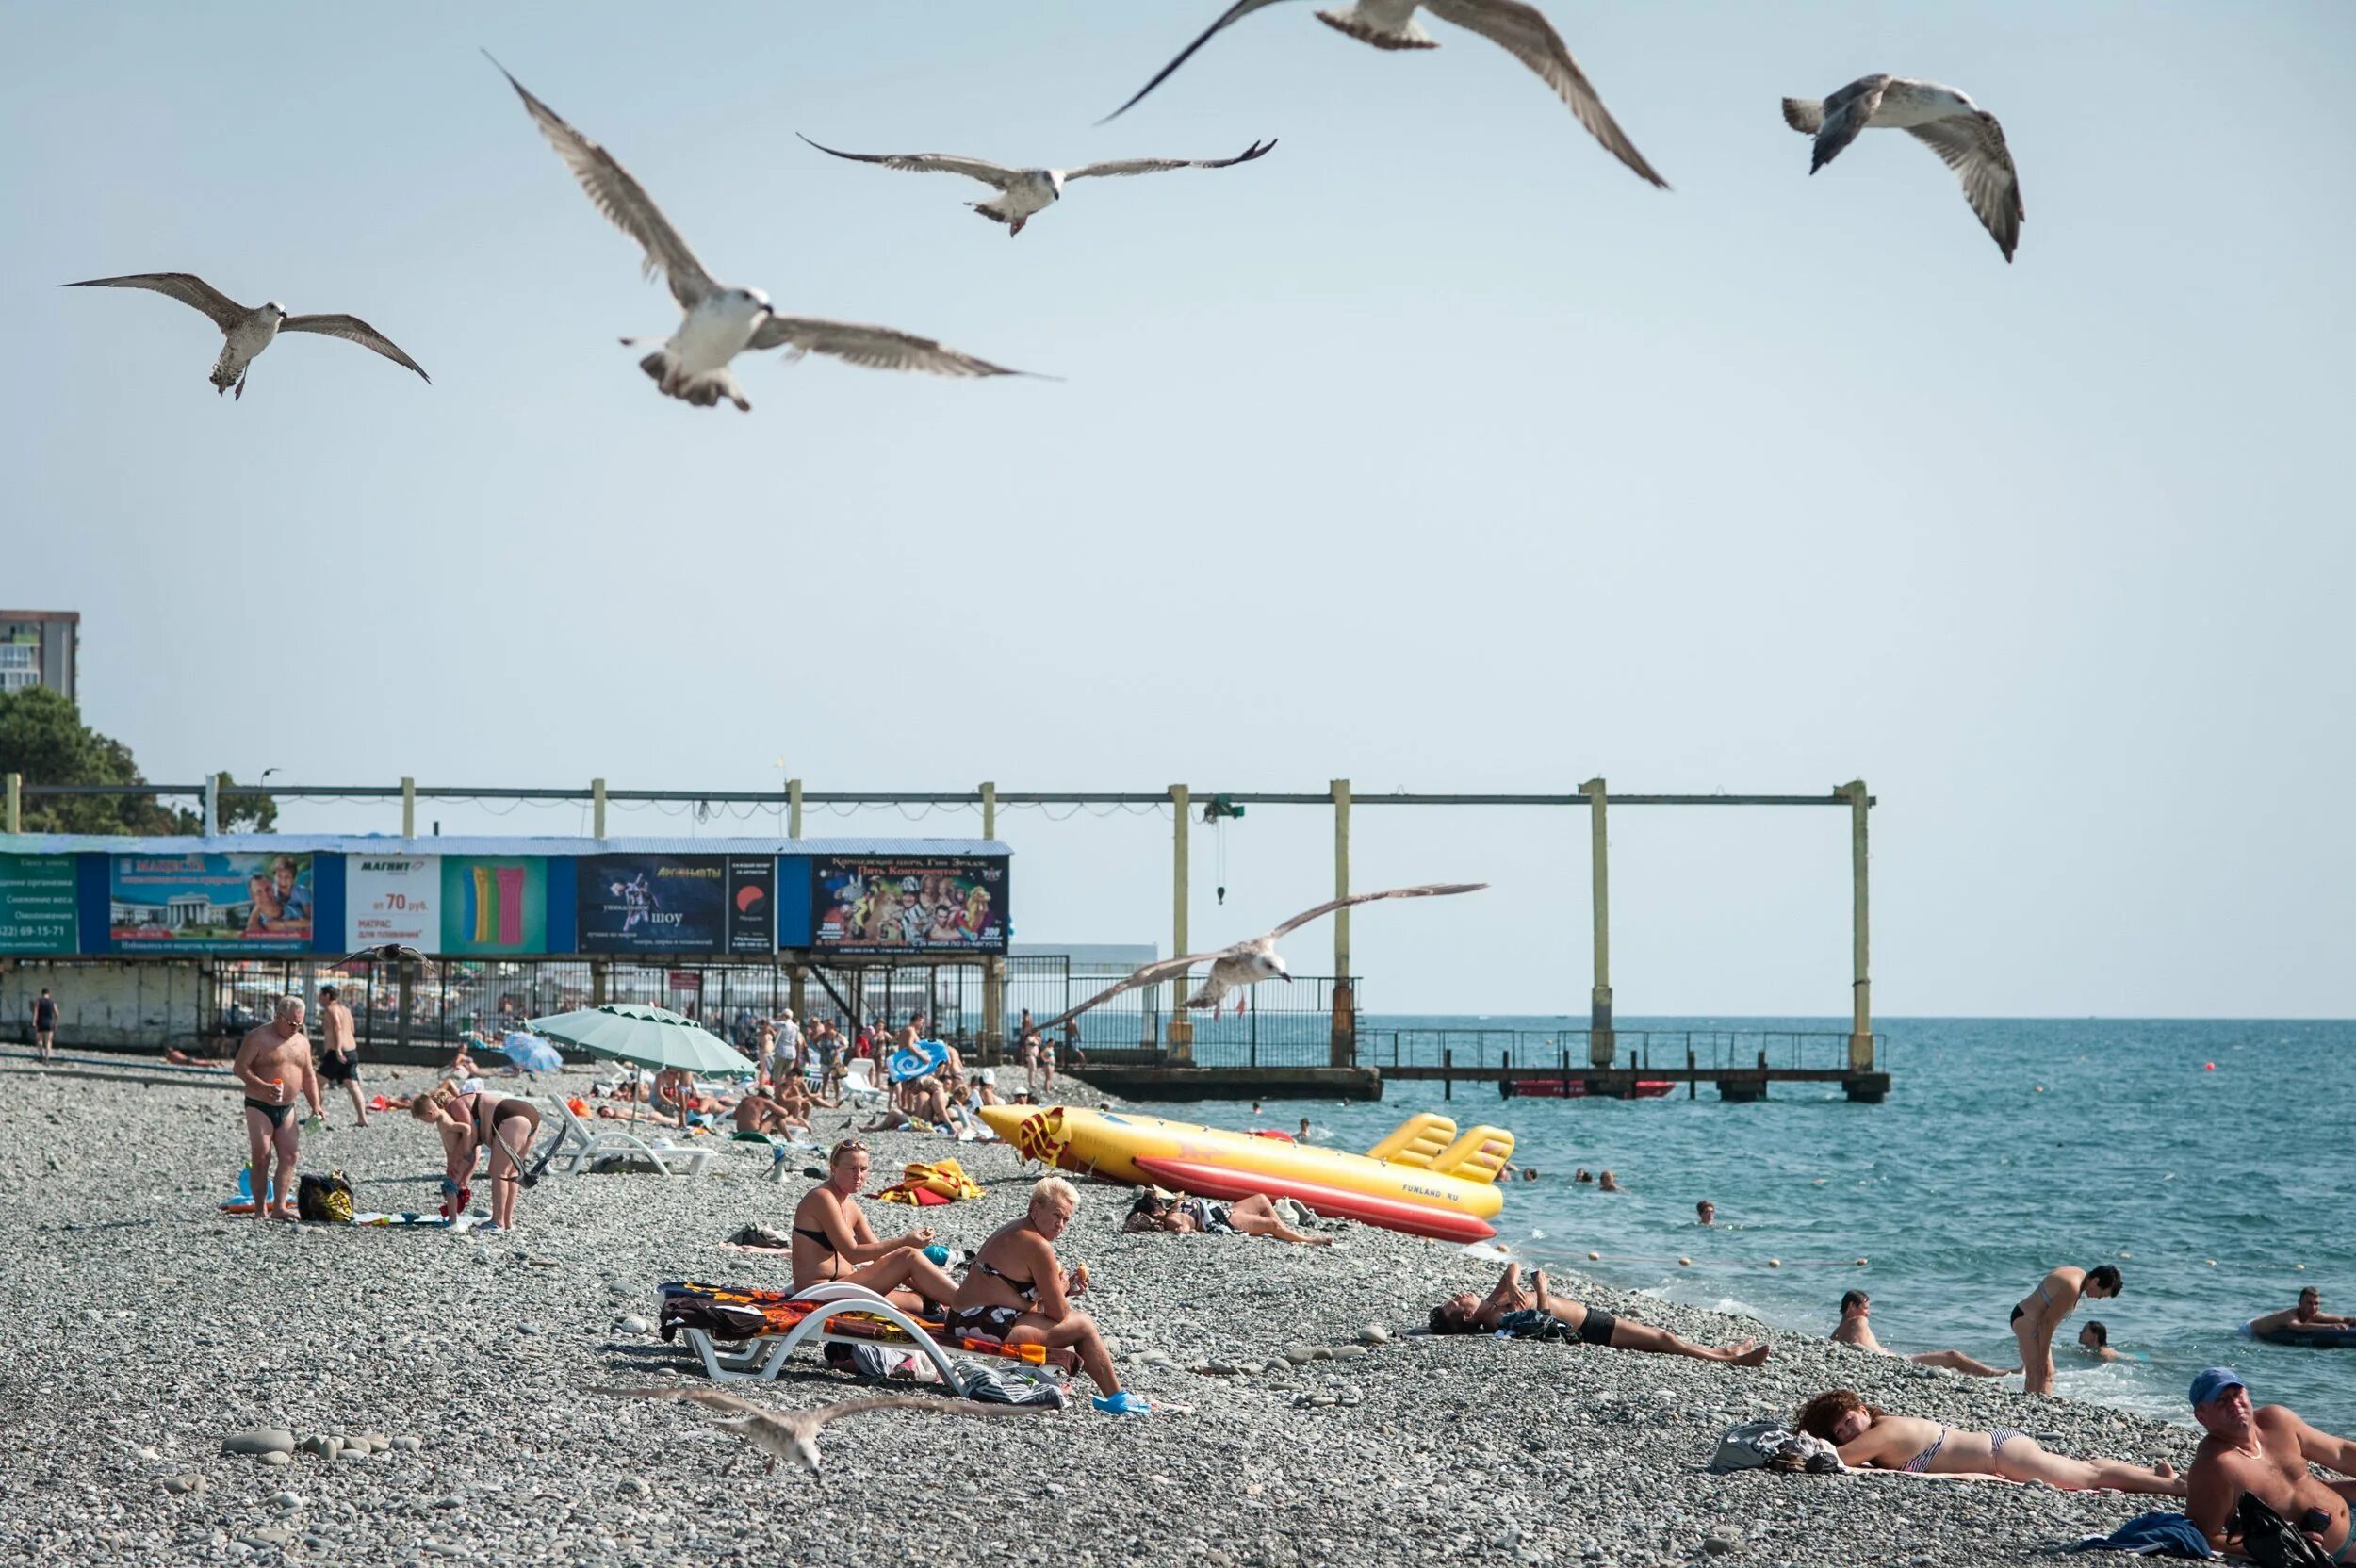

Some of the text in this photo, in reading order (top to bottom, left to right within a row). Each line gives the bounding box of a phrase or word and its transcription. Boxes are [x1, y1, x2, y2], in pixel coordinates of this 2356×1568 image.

[361, 861, 411, 872] МАГНИТ
[859, 866, 963, 876] Пять Континентов
[373, 902, 384, 910] от
[386, 893, 406, 910] 70
[358, 919, 392, 928] МАТРАС
[651, 912, 683, 927] шоу
[20, 925, 64, 936] 69-15-71
[1402, 1184, 1459, 1201] FUNLAND RU
